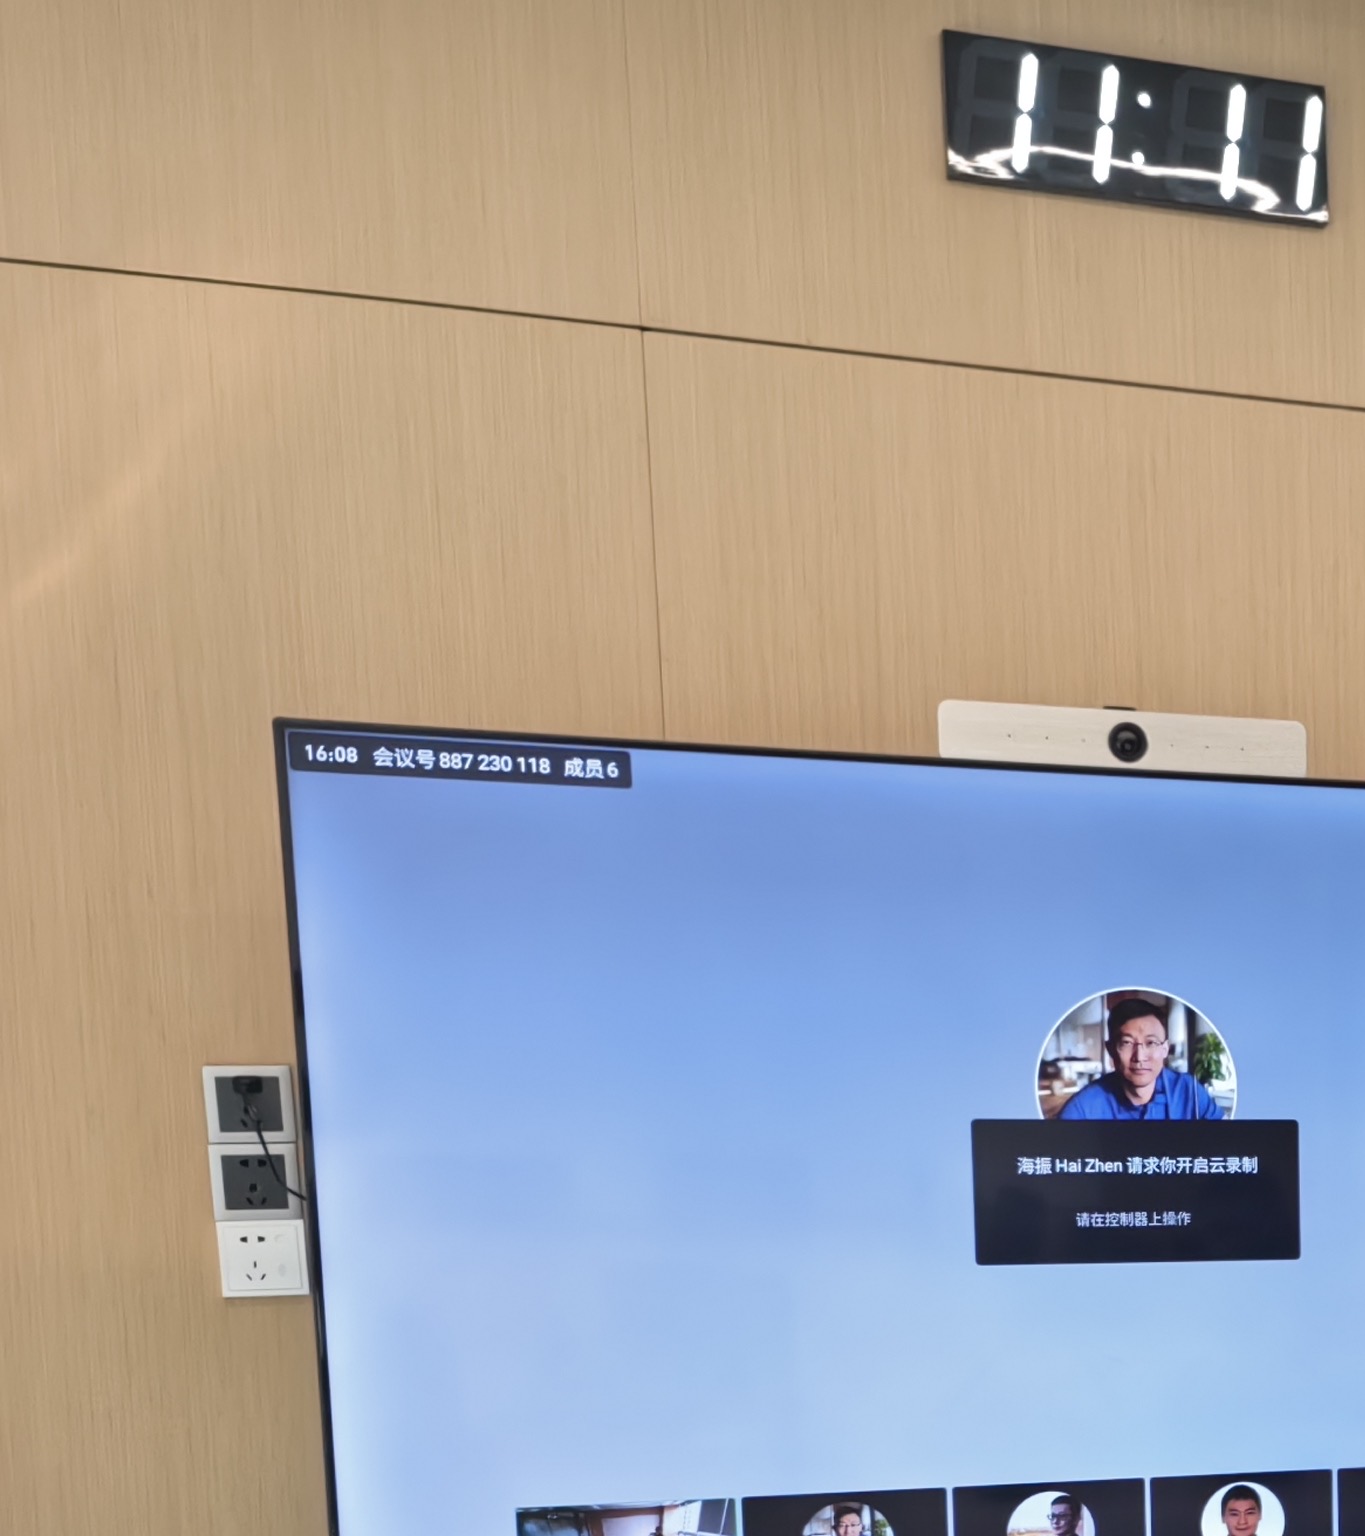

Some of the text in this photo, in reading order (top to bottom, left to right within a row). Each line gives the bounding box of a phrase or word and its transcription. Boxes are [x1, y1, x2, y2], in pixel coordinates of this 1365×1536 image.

[1011, 52, 1323, 212] 11:11
[304, 744, 618, 779] 16:08 会议号 887 230 118 成员 6
[1017, 1156, 1259, 1175] 海振 Hai Zhen 请求你开启云录制
[1076, 1211, 1192, 1228] 请在控制器上操作
